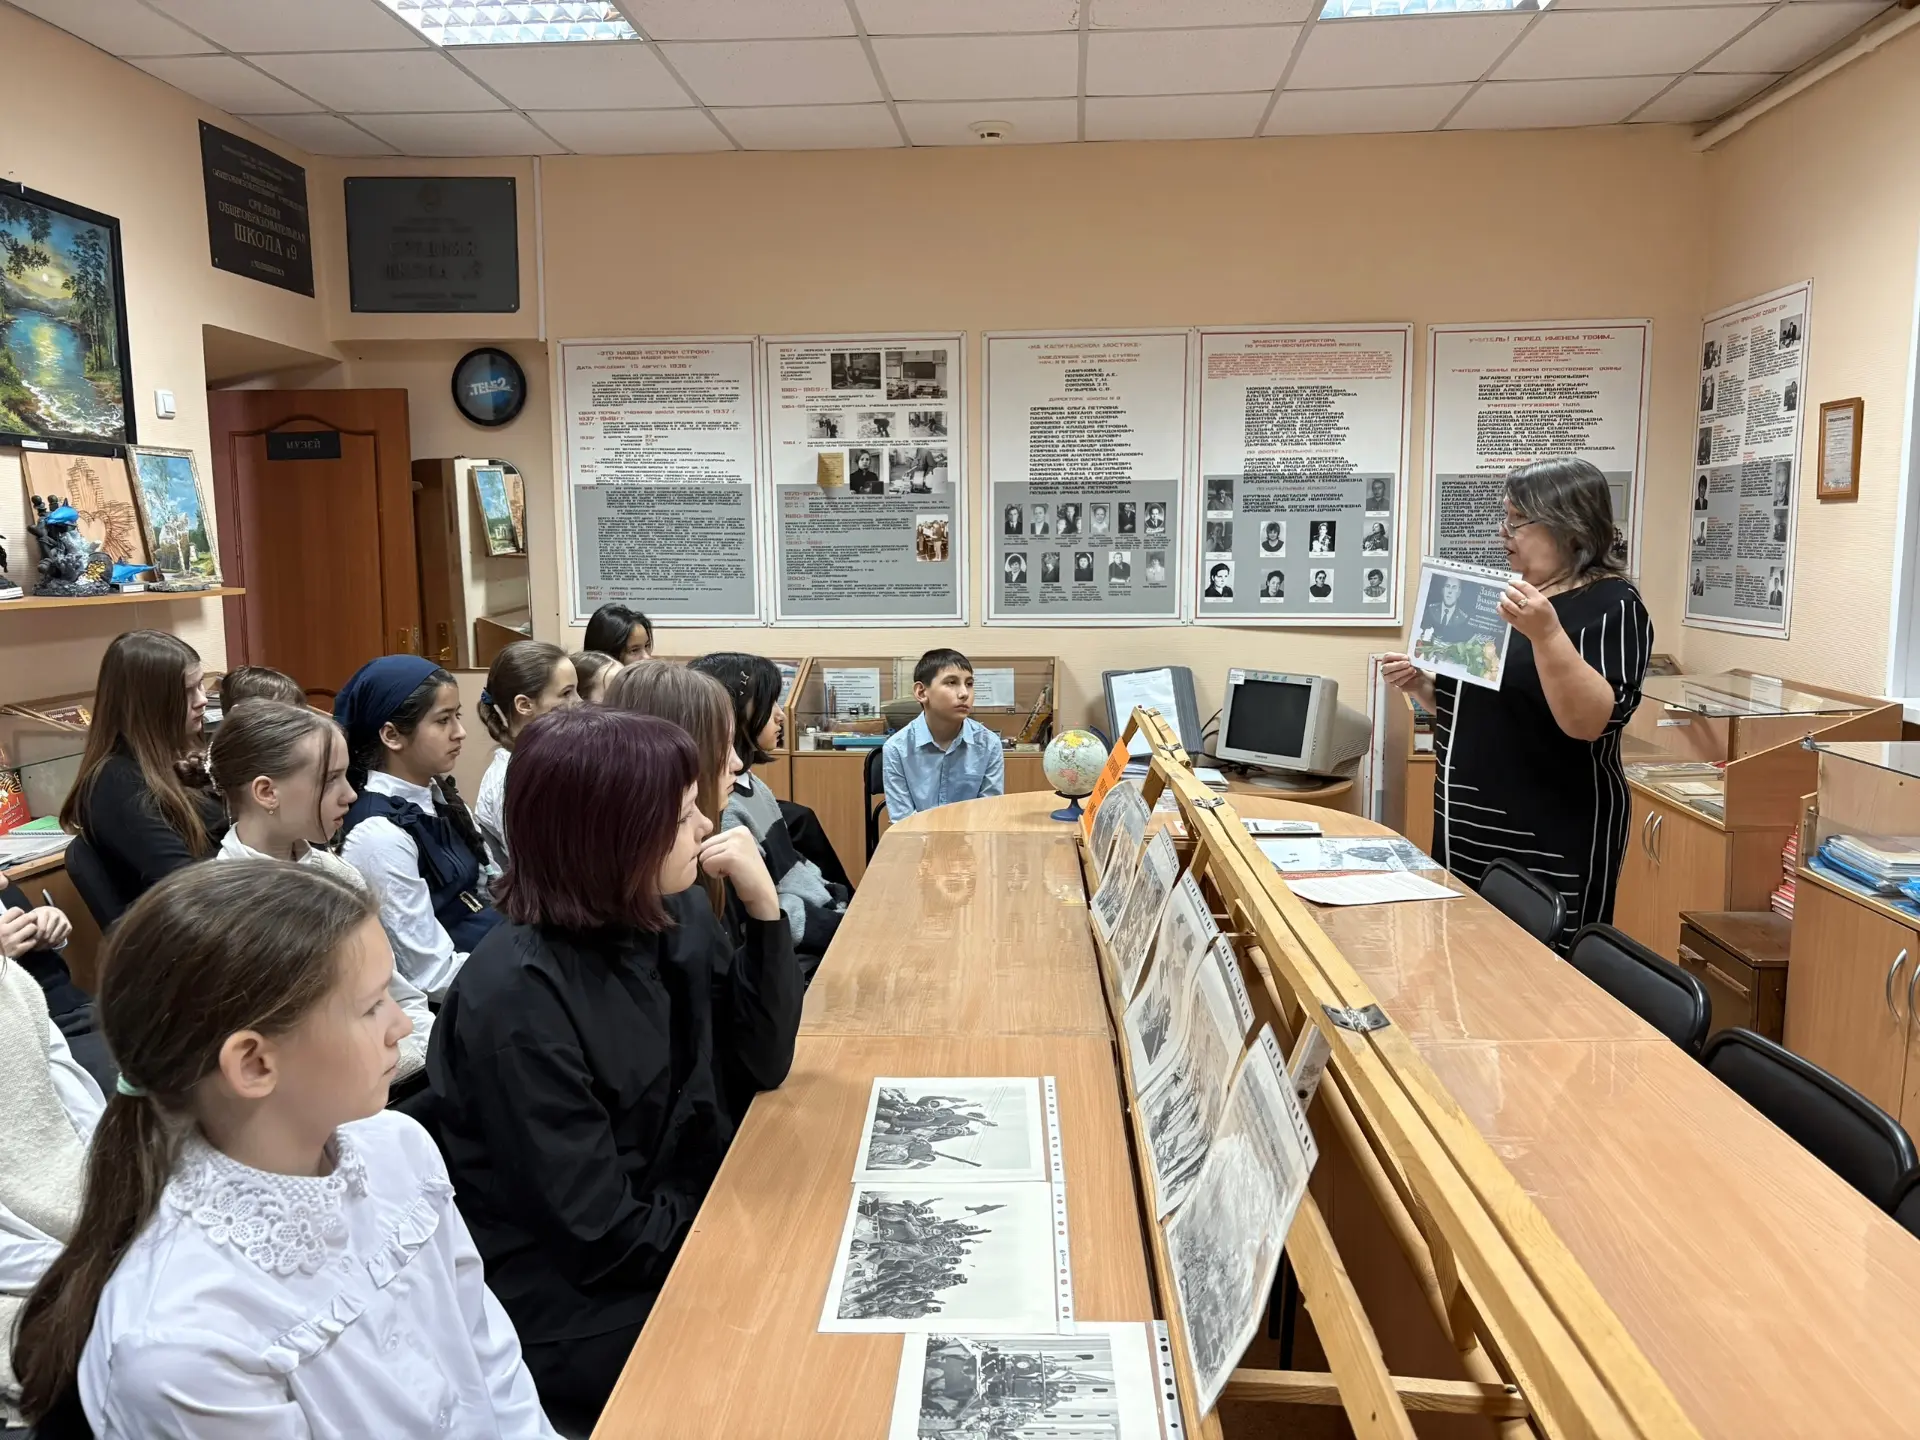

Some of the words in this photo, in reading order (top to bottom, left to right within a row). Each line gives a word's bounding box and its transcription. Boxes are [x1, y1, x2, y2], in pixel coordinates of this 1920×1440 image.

[219, 201, 306, 243] ОБЩЕОБРАЗОВАТЕЛЬНАЯ
[234, 223, 282, 257] ШКОЛА
[469, 377, 510, 396] TELE2
[286, 438, 321, 450] МУЗЕЙ
